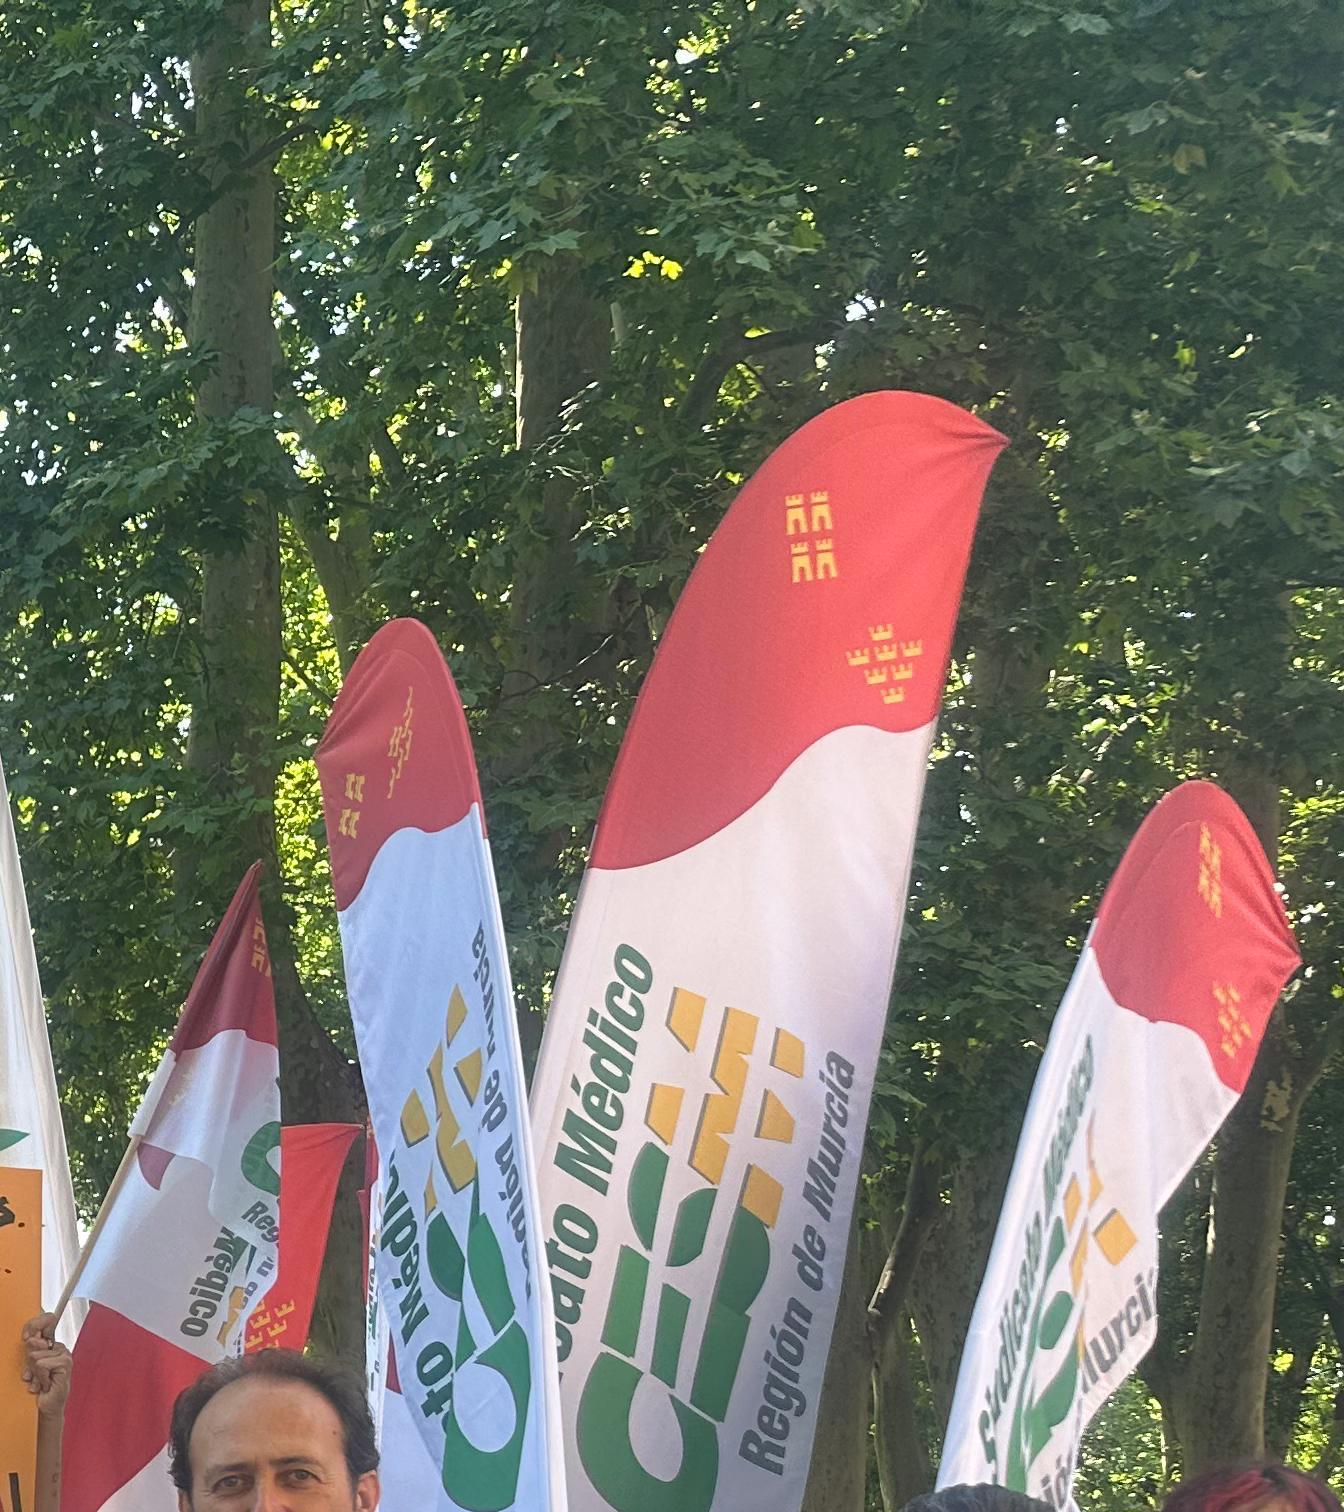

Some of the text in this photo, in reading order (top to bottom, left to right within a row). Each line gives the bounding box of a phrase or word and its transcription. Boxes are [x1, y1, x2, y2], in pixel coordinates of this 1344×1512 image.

[553, 942, 653, 1196] Médico
[738, 1050, 856, 1477] Región de Murcia
[1081, 1266, 1157, 1394] Murci
